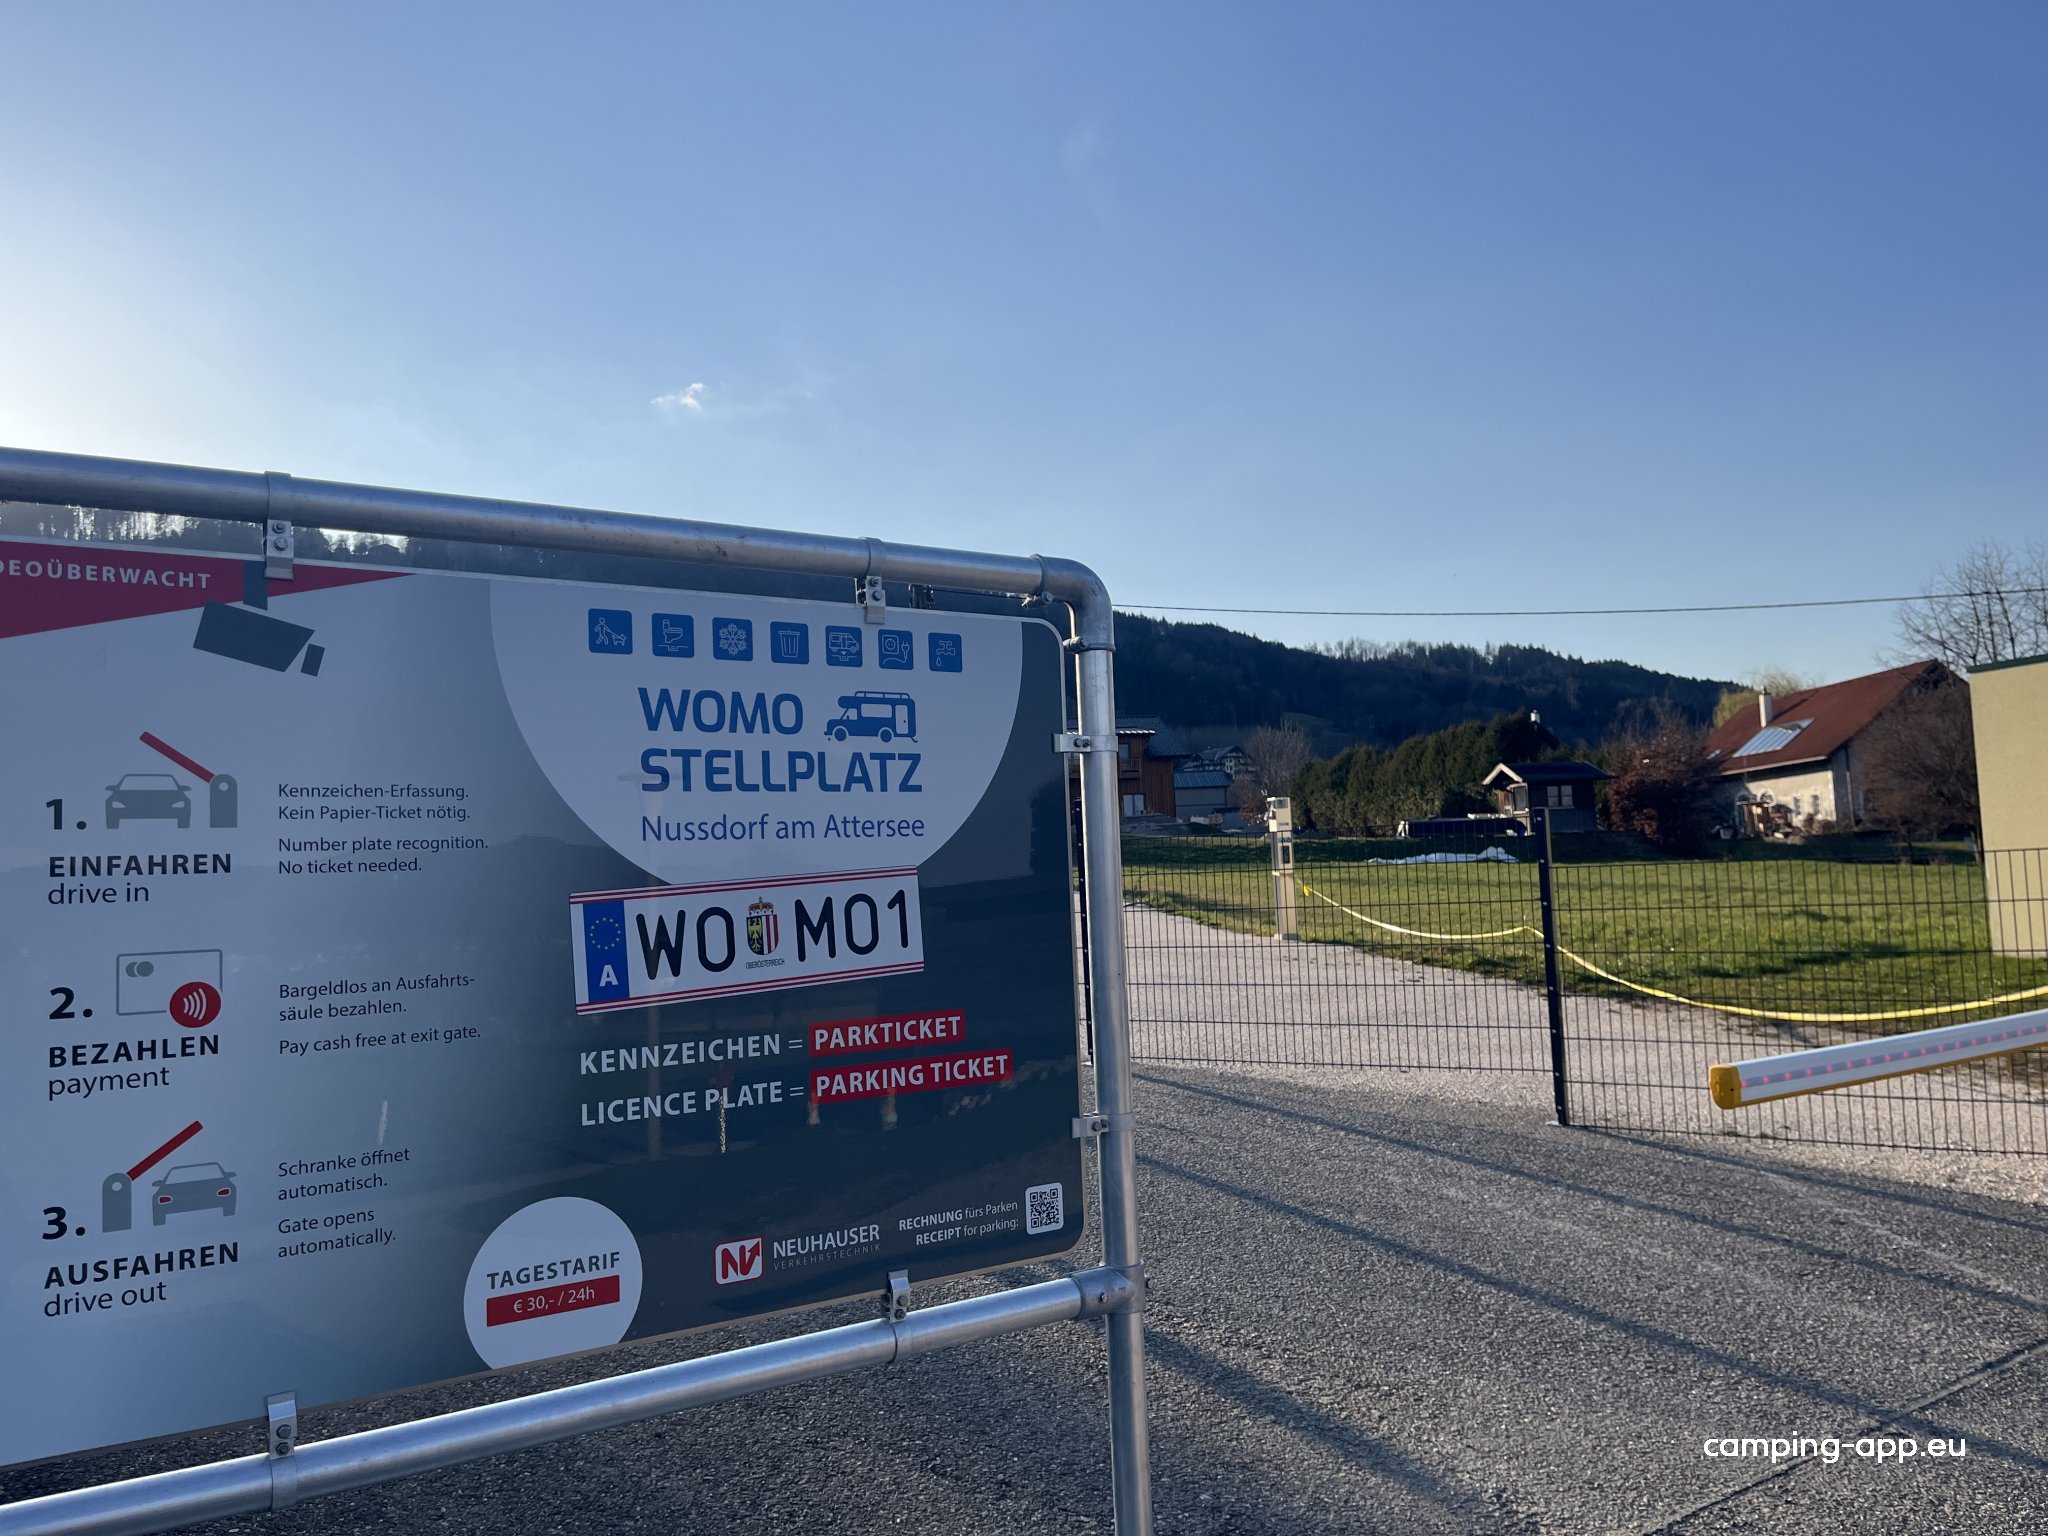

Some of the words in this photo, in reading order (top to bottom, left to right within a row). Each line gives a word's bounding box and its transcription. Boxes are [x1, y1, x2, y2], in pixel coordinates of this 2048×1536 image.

[0, 558, 211, 589] EOÜBERWACHT
[637, 687, 804, 734] WOMO
[641, 748, 923, 793] STELLPLATZ
[279, 783, 469, 801] Kennzeichen-Erfassung.
[46, 798, 87, 830] 1.
[279, 805, 314, 820] Kein
[320, 804, 422, 823] Papier-Ticket
[427, 804, 471, 823] nötig.
[642, 814, 769, 841] Nussdorf
[776, 819, 815, 839] am
[823, 814, 925, 839] Attersee
[279, 837, 347, 852] Number
[352, 836, 392, 854] plate
[397, 836, 488, 854] recognition.
[49, 853, 232, 878] EINFAHREN
[279, 859, 302, 875] No
[308, 858, 353, 874] ticket
[358, 858, 422, 873] needed.
[48, 882, 117, 905] drive
[127, 882, 149, 902] in
[636, 907, 736, 980] WO
[280, 979, 366, 1001] Bargeldlos
[373, 980, 391, 992] an
[396, 973, 475, 992] Ausfahrts-
[600, 965, 618, 987] A
[49, 987, 94, 1020] 2.
[280, 1004, 323, 1021] säule
[328, 1000, 407, 1018] bezahlen.
[49, 1034, 220, 1068] BEZAHLEN
[280, 1040, 309, 1057] Pay
[314, 1034, 351, 1051] cash
[355, 1032, 386, 1048] free
[391, 1032, 406, 1045] at
[411, 1028, 439, 1044] exit
[444, 1026, 481, 1045] gate.
[581, 1033, 780, 1075] KENNZEICHEN
[815, 1016, 961, 1050] PARKTICKET
[48, 1068, 170, 1101] payment
[581, 1090, 696, 1126] LICENCE
[705, 1081, 783, 1111] PLATE
[816, 1062, 925, 1097] PARKING
[930, 1054, 1009, 1081] TICKET
[278, 1154, 356, 1177] Schranke
[361, 1147, 410, 1166] öffnet
[278, 1174, 388, 1201] automatisch.
[42, 1206, 86, 1240] 3.
[278, 1216, 319, 1234] Gate
[323, 1210, 375, 1232] opens
[899, 1209, 963, 1231] RECHNUNG
[965, 1206, 983, 1220] fürs
[985, 1200, 1018, 1216] Parken
[278, 1227, 397, 1258] automatically.
[773, 1224, 880, 1259] NEUHAUSER
[916, 1226, 961, 1246] RECEIPT
[964, 1224, 977, 1236] for
[979, 1217, 1019, 1237] parking:
[44, 1242, 239, 1289] AUSFAHREN
[487, 1251, 620, 1290] TAGESTARIF
[773, 1243, 881, 1271] VERKEHRSTECHNIK
[44, 1291, 113, 1317] drive
[121, 1281, 167, 1306] out
[513, 1299, 523, 1314] €
[527, 1295, 554, 1311] 30,-
[568, 1286, 595, 1304] 24h
